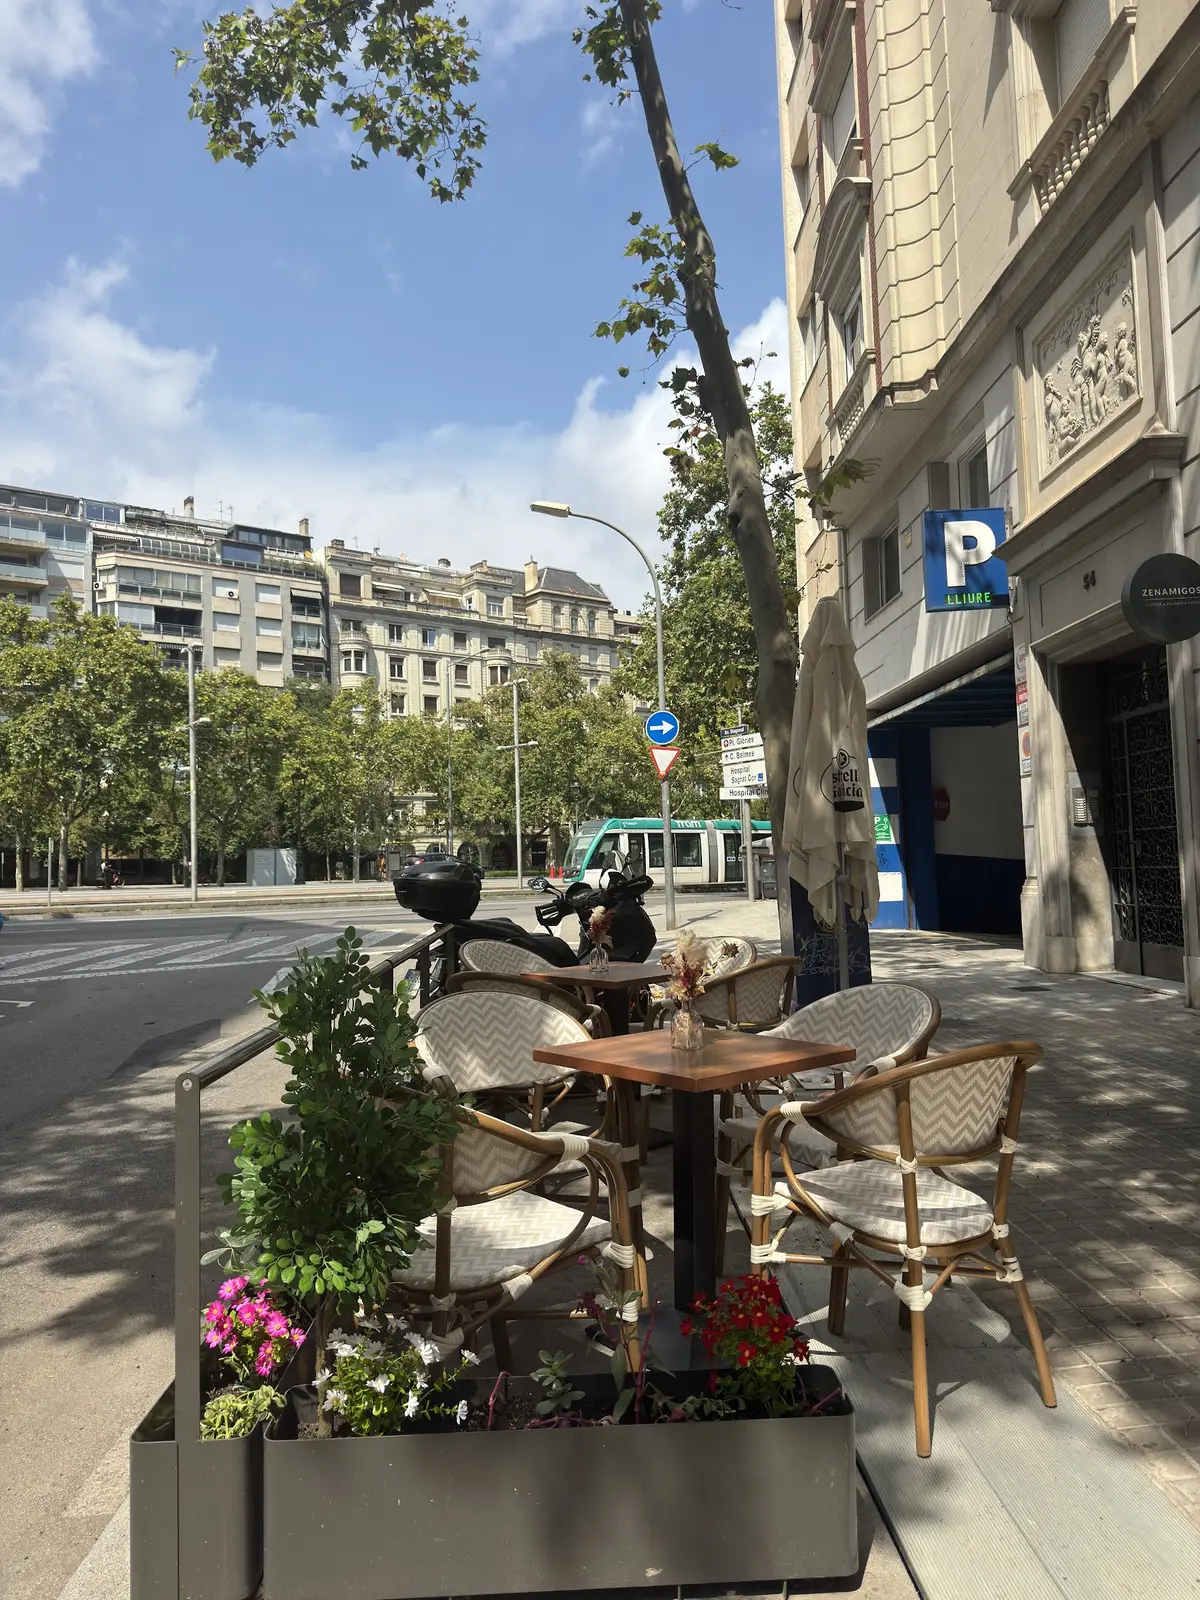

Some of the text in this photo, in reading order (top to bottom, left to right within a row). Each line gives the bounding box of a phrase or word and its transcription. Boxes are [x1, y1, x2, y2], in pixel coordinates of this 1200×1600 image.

[944, 520, 996, 588] P
[1142, 586, 1200, 596] ZENAMIGOS
[947, 592, 991, 605] LLIURE
[736, 751, 755, 759] Balmes
[730, 765, 750, 774] Hospital
[729, 789, 754, 797] Hospital
[933, 801, 949, 810] STOP
[874, 816, 881, 824] P
